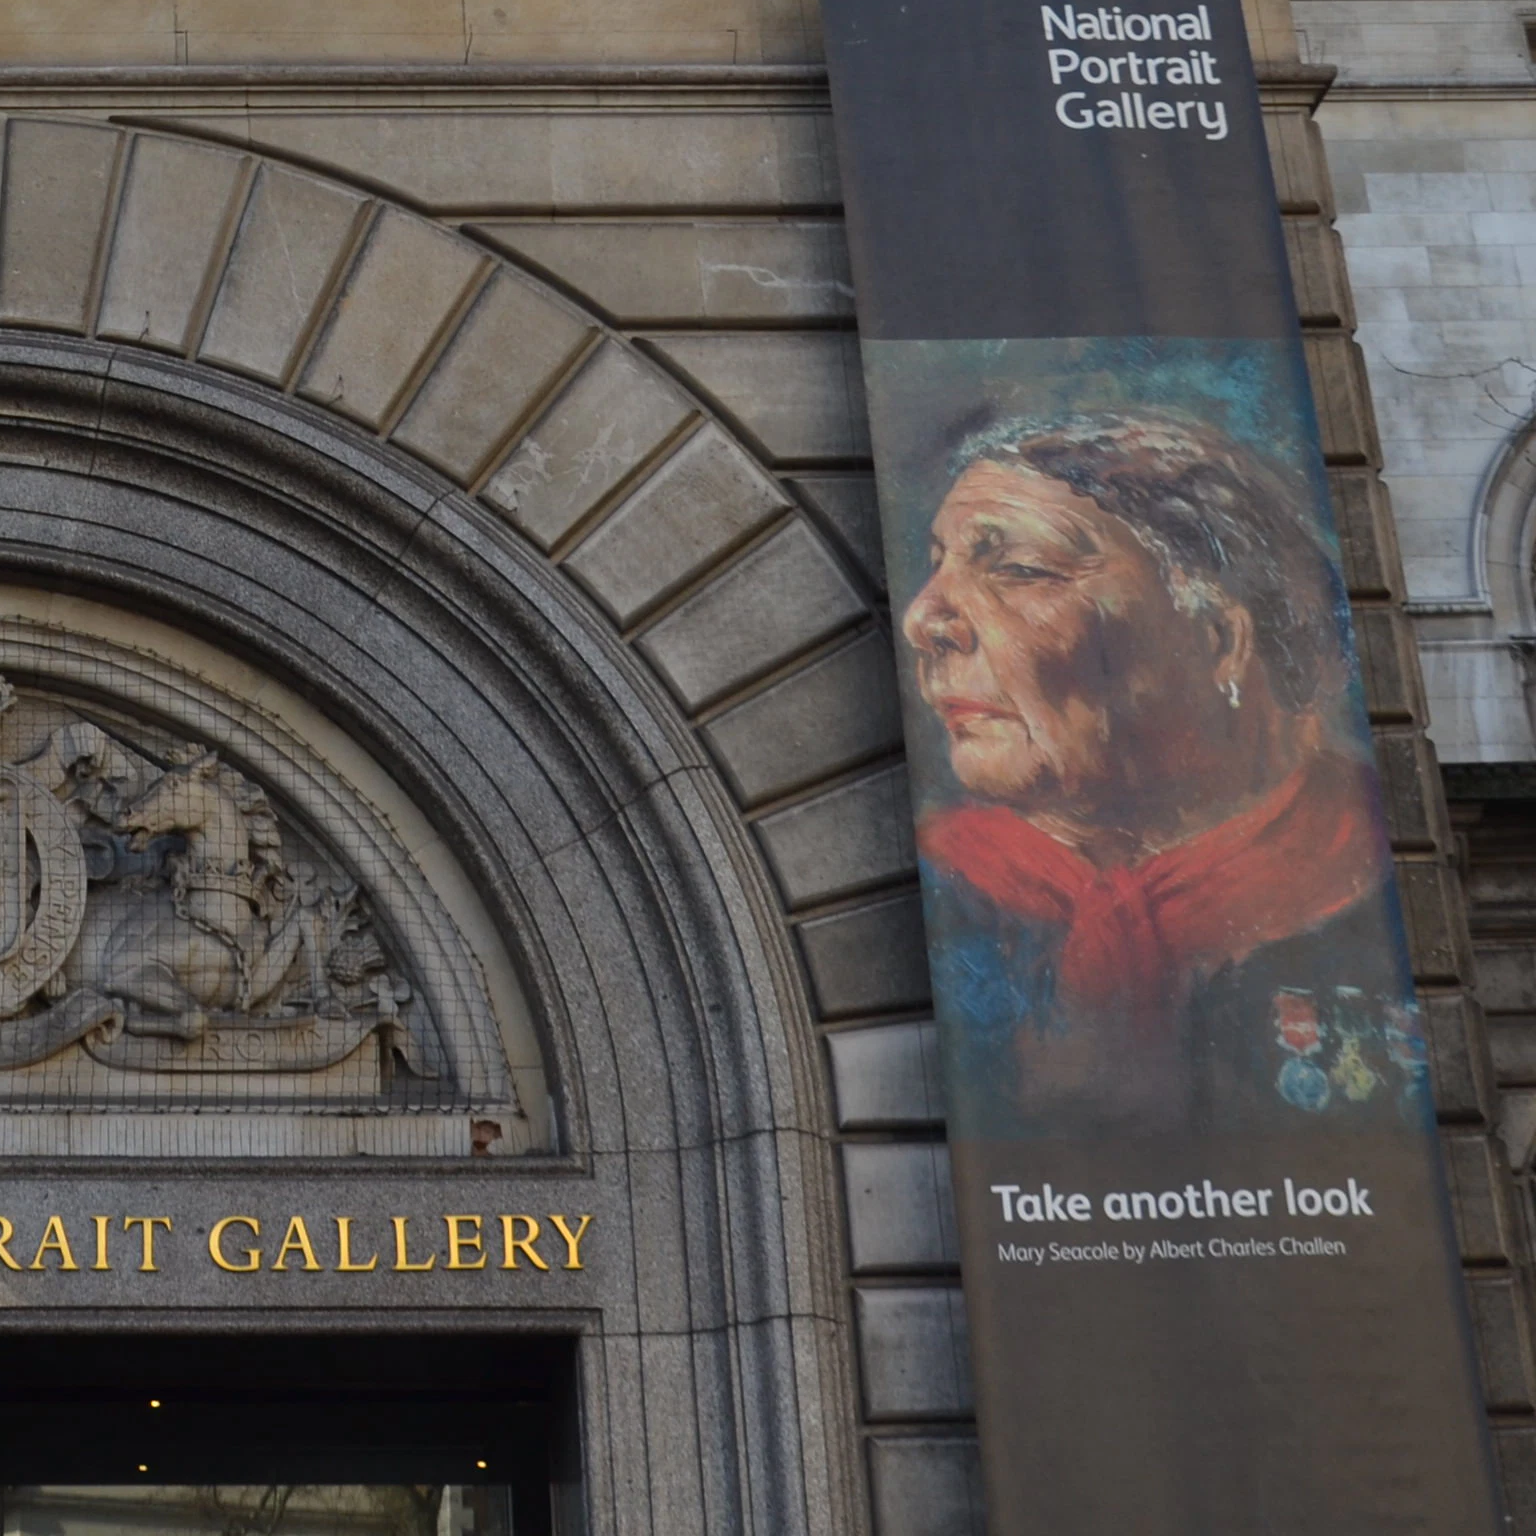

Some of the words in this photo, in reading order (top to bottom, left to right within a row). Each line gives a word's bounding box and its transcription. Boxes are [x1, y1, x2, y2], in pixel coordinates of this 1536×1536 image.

[1040, 4, 1212, 41] National
[1048, 48, 1222, 85] Portrait
[1055, 91, 1228, 140] Gallery
[989, 1182, 1093, 1222] Take
[1102, 1179, 1274, 1221] another
[1282, 1177, 1375, 1216] look
[207, 1213, 592, 1272] GALLERY
[997, 1242, 1046, 1266] Mary
[1048, 1241, 1120, 1261] Seacole
[1122, 1241, 1146, 1265] by
[1149, 1239, 1205, 1259] Albert
[1208, 1237, 1277, 1257] Charles
[1278, 1236, 1347, 1257] Challen
